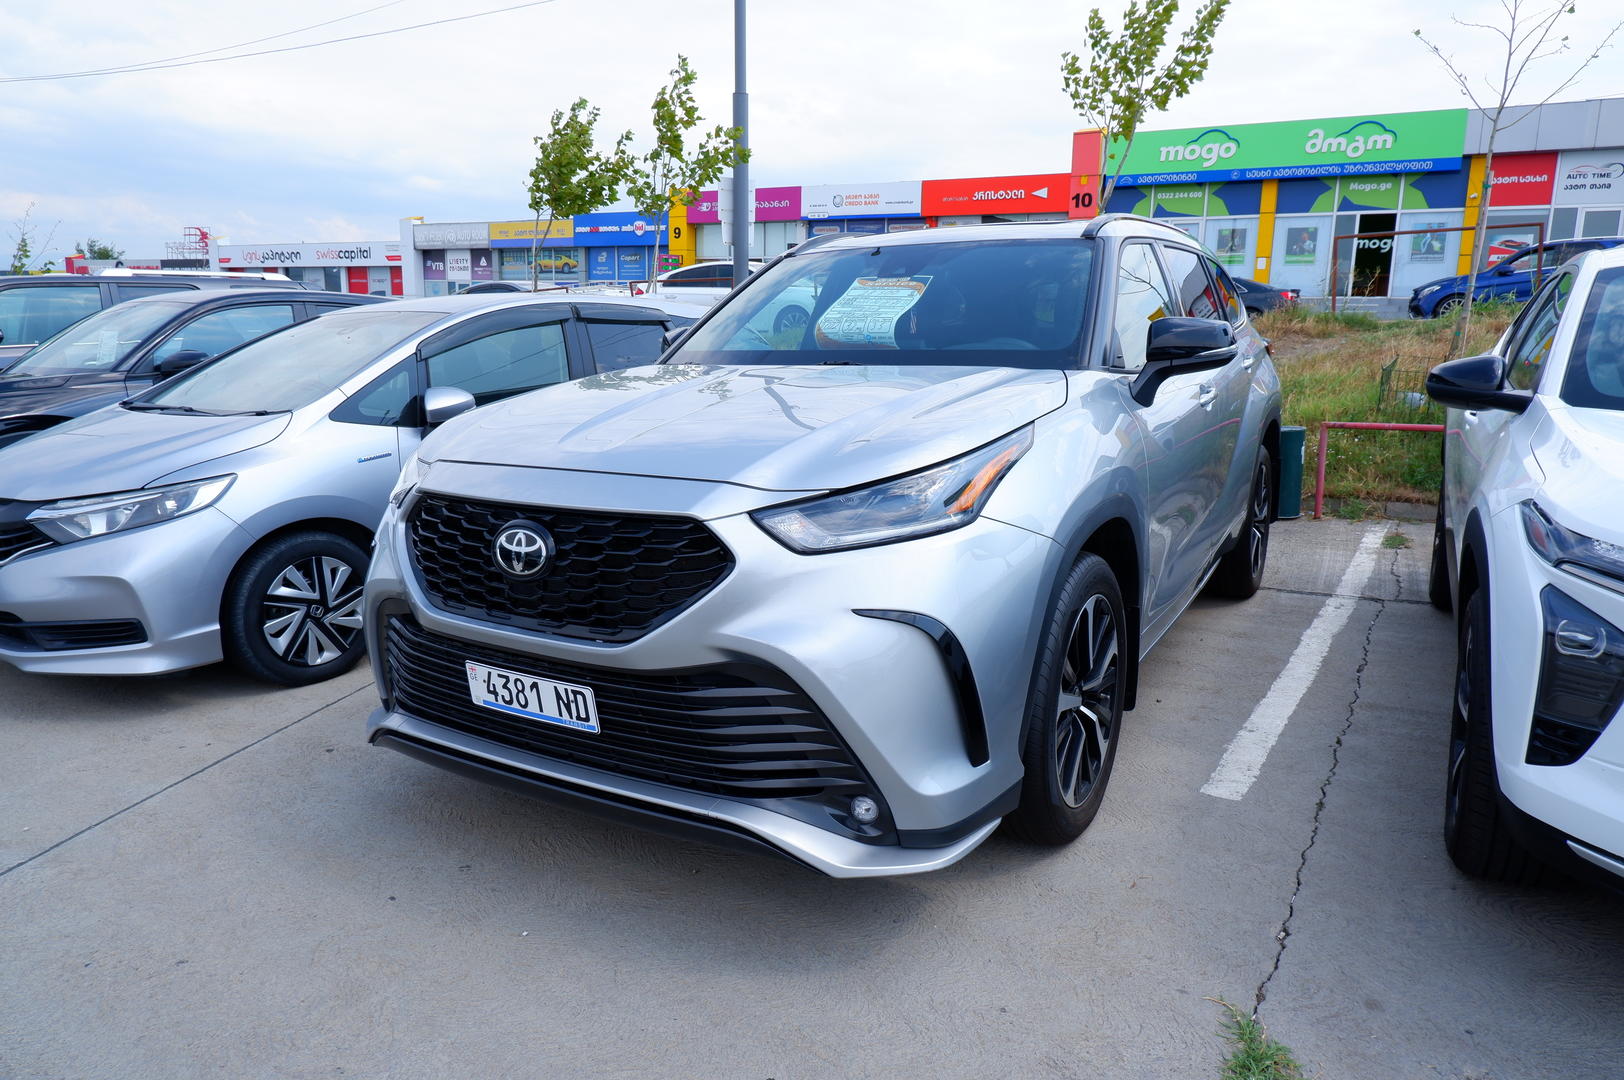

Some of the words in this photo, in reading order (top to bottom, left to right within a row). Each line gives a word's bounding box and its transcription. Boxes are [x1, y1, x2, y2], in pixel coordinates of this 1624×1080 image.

[1305, 128, 1393, 158] მოგო
[1159, 142, 1237, 168] mogo
[1246, 169, 1272, 178] სესხი
[1350, 182, 1392, 191] Mogo.ge
[972, 189, 1025, 201] კრისტალი
[1071, 193, 1093, 208] 10
[673, 227, 682, 239] 9
[316, 246, 372, 262] swisscapital
[486, 670, 544, 713] 4381
[553, 685, 591, 723] ND
